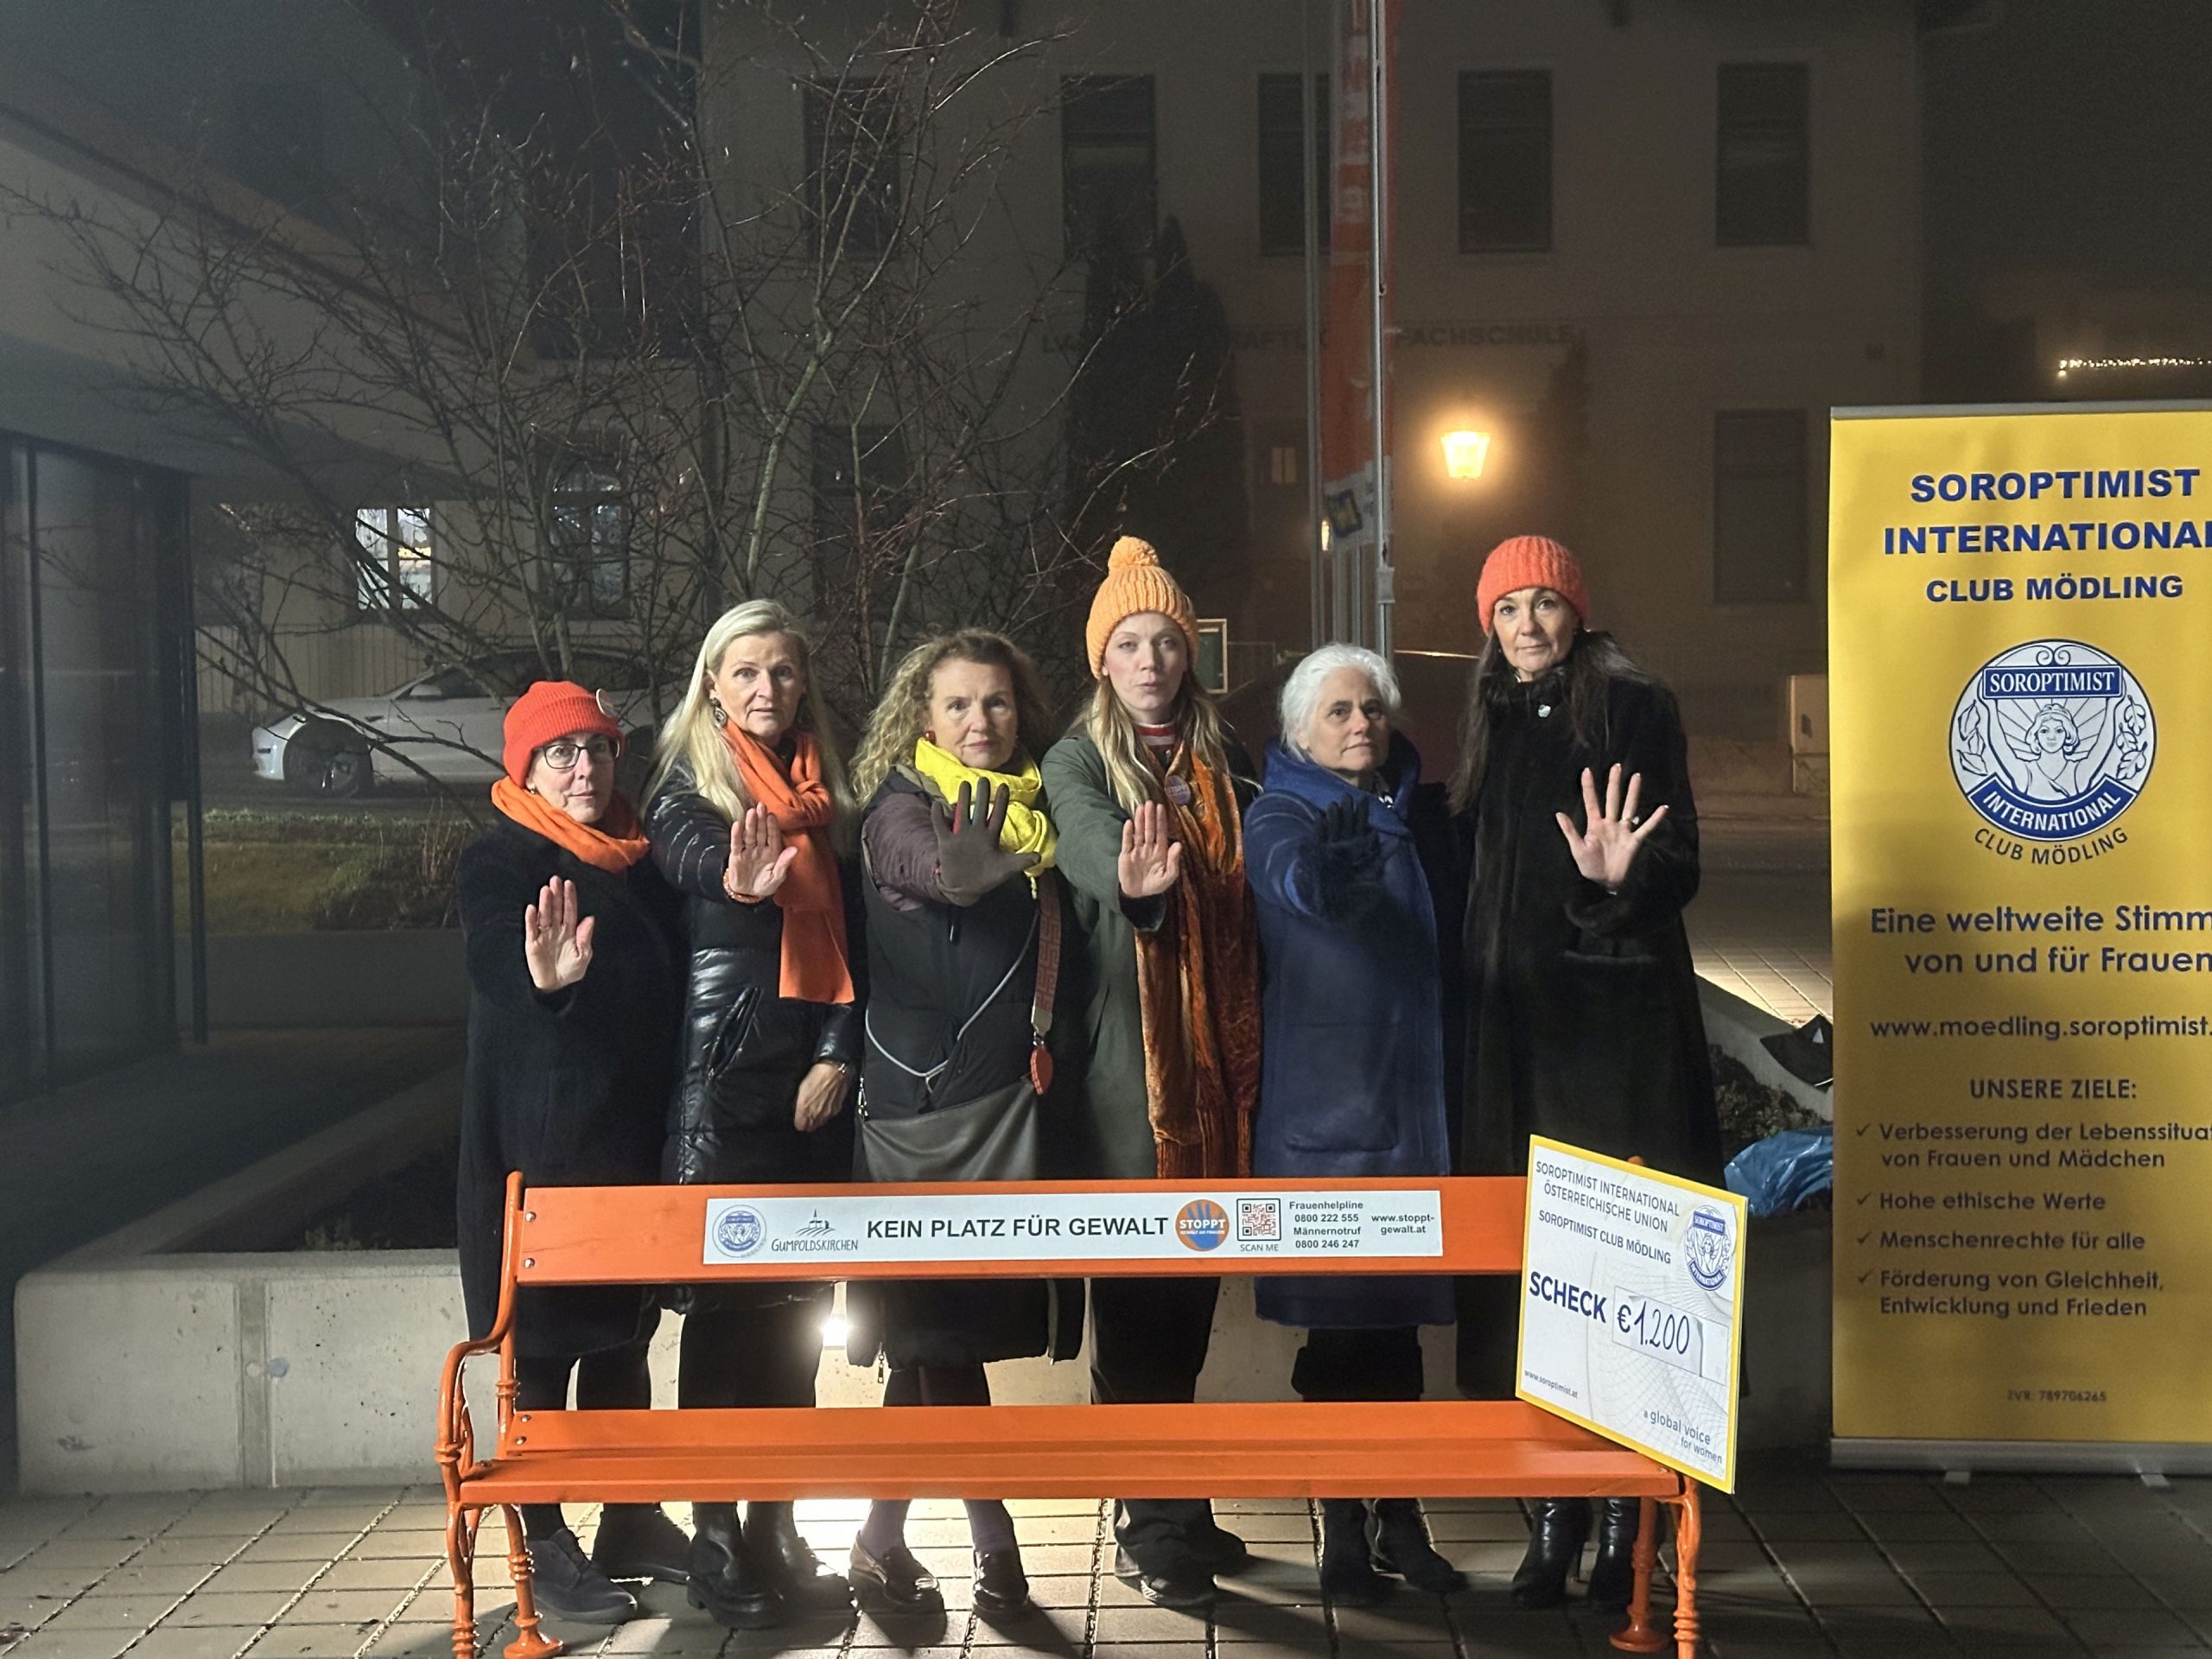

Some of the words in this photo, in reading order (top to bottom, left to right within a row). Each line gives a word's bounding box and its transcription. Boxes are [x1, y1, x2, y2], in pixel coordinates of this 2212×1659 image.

[1910, 469, 2201, 503] SOROPTIMIST
[1926, 579, 2014, 602] CLUB
[2026, 573, 2184, 600] MÖDLING
[1989, 672, 2115, 693] SOROPTIMIST
[1982, 790, 2121, 831] INTERNATIONAL
[1974, 827, 2024, 861] CLUB
[2031, 826, 2128, 865] MÖDLING
[1871, 908, 1936, 933] Eine
[1947, 906, 2104, 932] weltweite
[2115, 905, 2212, 931] Stimm
[1904, 952, 1963, 973] von
[1975, 947, 2037, 973] und
[2048, 946, 2090, 973] für
[2101, 947, 2212, 972] Frauen
[1969, 1079, 2063, 1099] UNSERE
[2071, 1079, 2137, 1099] ZIELE:
[1879, 1123, 2028, 1144] Verbesserung
[2036, 1123, 2071, 1141] der
[1881, 1154, 1919, 1167] von
[1927, 1150, 2000, 1167] Frauen
[2009, 1149, 2050, 1167] und
[2059, 1149, 2165, 1167] Mädchen
[1535, 1161, 1598, 1191] SOROPTIMIST
[1599, 1180, 1680, 1217] INTERNATIONAL
[1289, 1200, 1363, 1211] Frauenhelpline
[1544, 1179, 1631, 1221] ÖSTERREICHISCHE
[1634, 1211, 1668, 1232] UNION
[1879, 1192, 1936, 1210] Hohe
[1942, 1192, 2035, 1210] ethische
[2044, 1192, 2106, 1210] Werte
[867, 1220, 922, 1238] KEIN
[931, 1219, 1005, 1237] PLATZ
[1013, 1214, 1061, 1236] FÜR
[1069, 1217, 1168, 1236] GEWALT
[1179, 1219, 1225, 1230] STOPPT
[1294, 1214, 1318, 1223] 0800
[1320, 1214, 1338, 1223] 222
[1341, 1213, 1359, 1223] 555
[1371, 1214, 1434, 1224] www.stoppt-
[1294, 1226, 1361, 1236] Männernotruf
[1381, 1224, 1426, 1236] gewalt.at
[1538, 1210, 1599, 1239] SOROPTIMIST
[1599, 1230, 1624, 1248] CLUB
[1626, 1238, 1671, 1264] MÖDLING
[1879, 1231, 2064, 1249] Menschenrechte
[2072, 1231, 2099, 1249] für
[2107, 1231, 2145, 1249] alle
[1295, 1240, 1319, 1249] 0800
[1321, 1240, 1339, 1249] 246
[1342, 1239, 1359, 1249] 247
[1881, 1270, 1989, 1291] Förderung
[1998, 1274, 2037, 1288] von
[2045, 1271, 2164, 1290] Gleichheit,
[1529, 1271, 1607, 1323] SCHECK
[1881, 1297, 2010, 1319] Entwicklung
[2018, 1298, 2058, 1315] und
[2066, 1298, 2147, 1315] Frieden
[1523, 1370, 1578, 1398] www.soroptimist.at
[1650, 1410, 1681, 1433] global
[1684, 1426, 1711, 1445] voice
[1681, 1436, 1692, 1450] for
[1694, 1444, 1722, 1464] women
